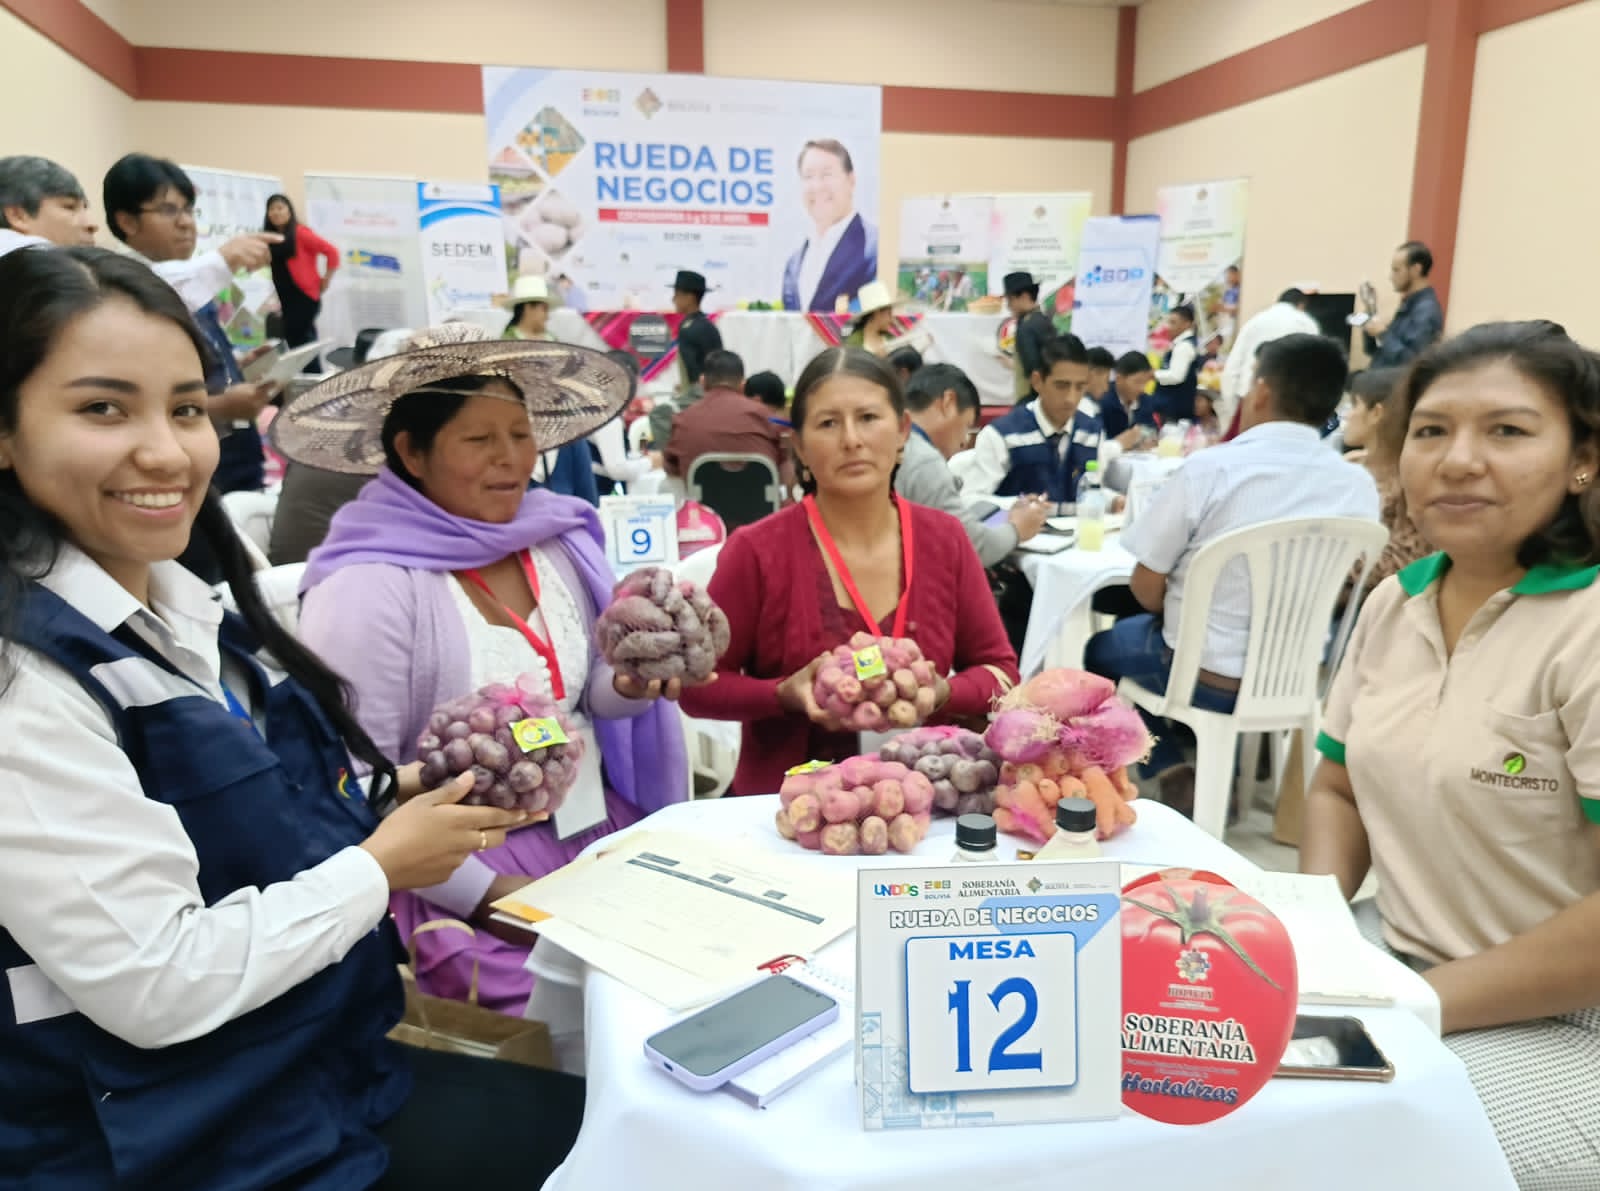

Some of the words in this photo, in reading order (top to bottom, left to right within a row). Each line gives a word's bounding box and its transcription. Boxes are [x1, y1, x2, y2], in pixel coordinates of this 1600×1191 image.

[594, 141, 717, 173] RUEDA
[728, 147, 774, 174] DE
[596, 175, 774, 206] NEGOCIOS
[431, 241, 493, 259] SEDEM
[631, 528, 652, 556] 9
[1471, 767, 1559, 792] MONTECRISTO
[958, 888, 1022, 898] ALIMENTARIA
[962, 879, 1017, 890] SOBERANÍA
[890, 909, 960, 929] RUEDA
[964, 907, 993, 926] DE
[996, 904, 1099, 925] NEGOCIOS
[949, 939, 1036, 961] MESA
[948, 976, 1043, 1076] 12
[1125, 1014, 1246, 1042] SOBERANÍA
